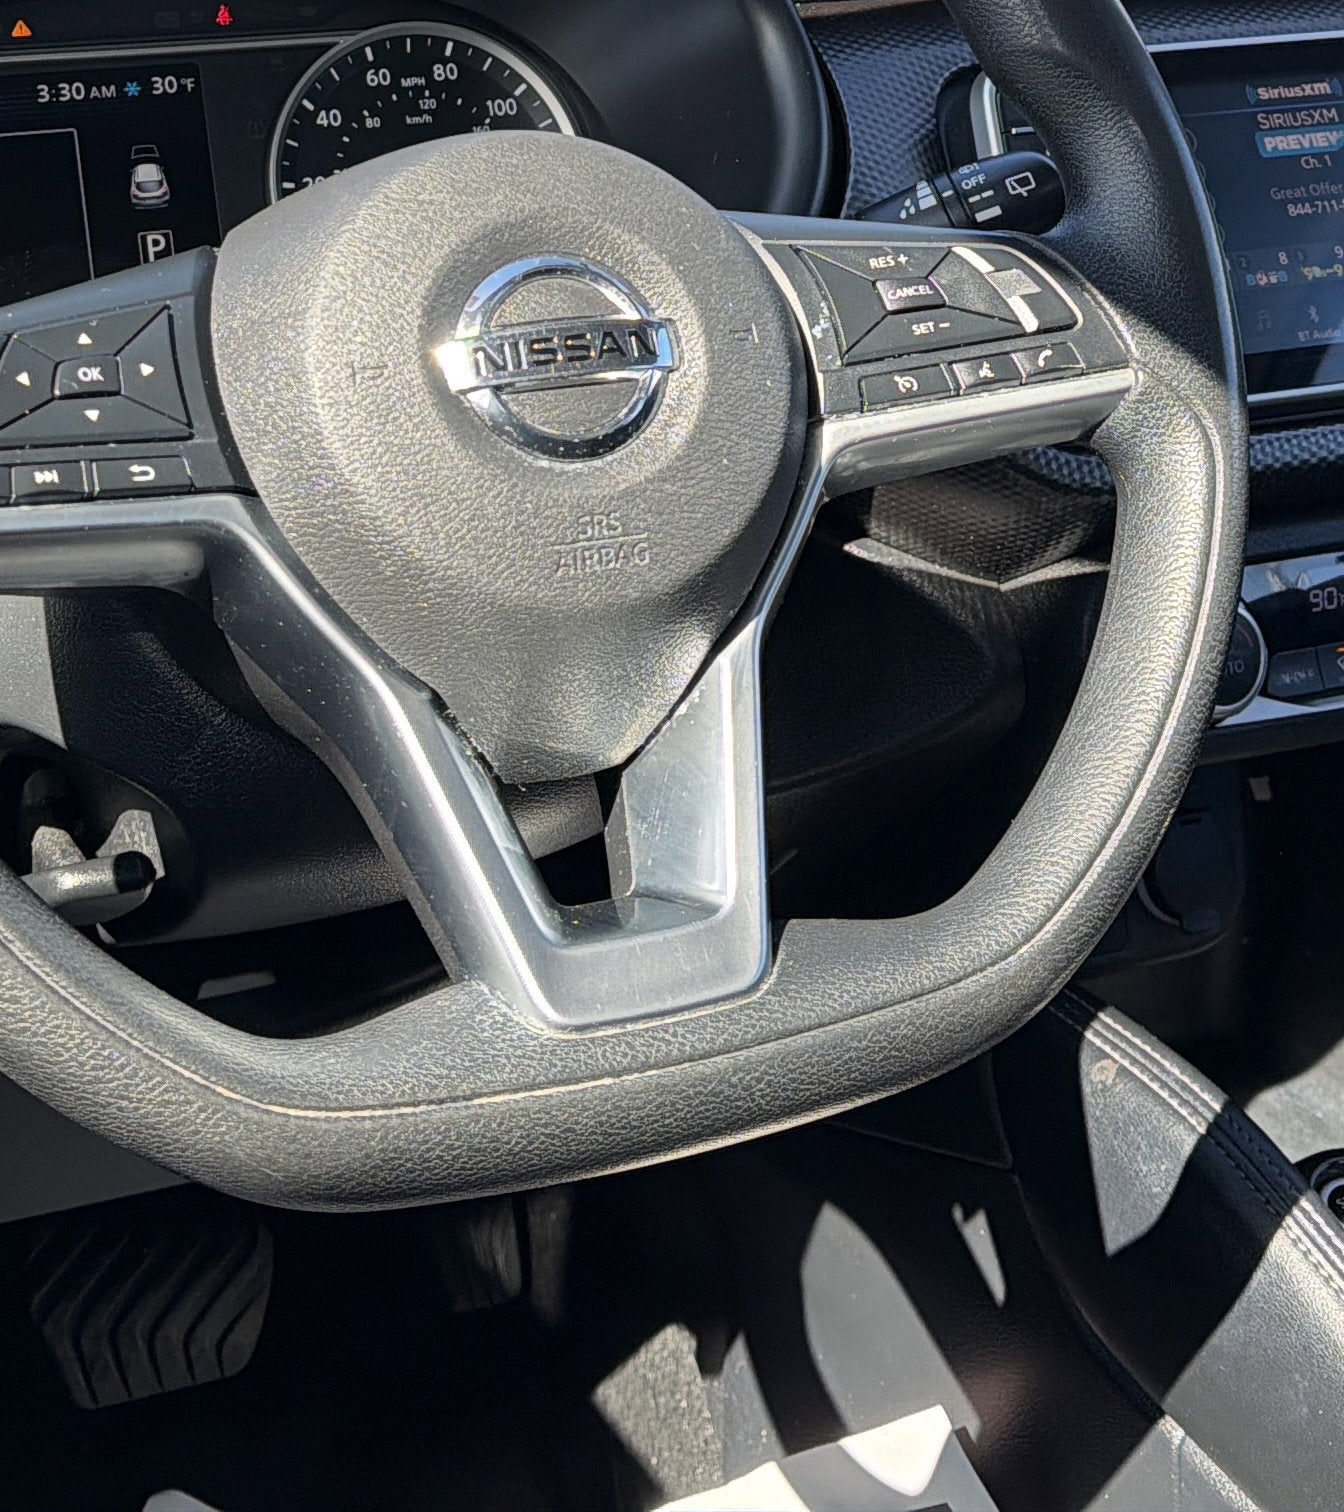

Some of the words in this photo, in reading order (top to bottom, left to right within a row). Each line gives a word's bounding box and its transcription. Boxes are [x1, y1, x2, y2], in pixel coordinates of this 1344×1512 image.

[365, 68, 391, 87] 60
[400, 75, 426, 88] MPH
[432, 63, 458, 82] 80
[36, 81, 86, 103] 3:30
[89, 85, 117, 100] AM
[316, 109, 342, 128] 40
[418, 98, 437, 110] 120
[485, 98, 518, 117] 100
[365, 116, 381, 129] 80
[405, 114, 433, 126] km/h
[1257, 107, 1339, 130] SIRIUSXM
[961, 173, 987, 190] OFF
[1270, 183, 1306, 201] Great
[1309, 179, 1343, 197] Offer
[145, 233, 166, 263] P
[1277, 251, 1289, 265] 8
[1333, 244, 1344, 259] 9
[868, 255, 896, 270] RES
[887, 284, 935, 300] CANCEL
[911, 321, 935, 336] SET
[472, 328, 660, 379] NISSAN
[76, 366, 105, 383] OK
[577, 512, 623, 540] SRS
[556, 541, 651, 576] AIRBAG
